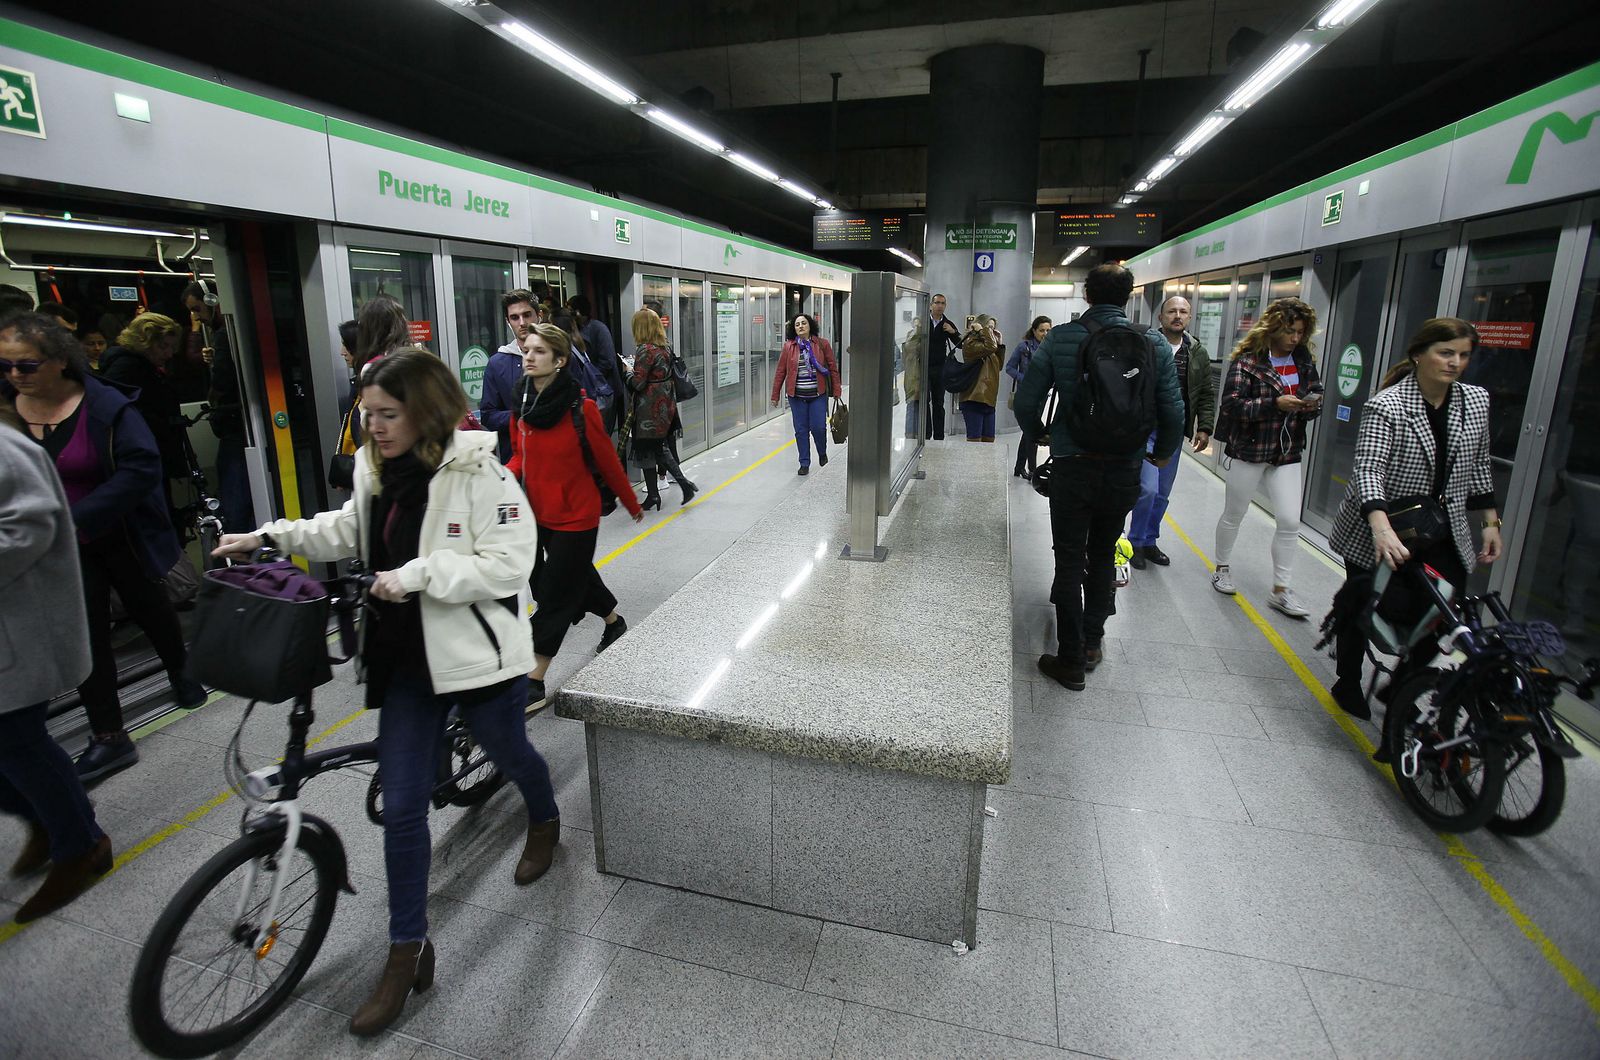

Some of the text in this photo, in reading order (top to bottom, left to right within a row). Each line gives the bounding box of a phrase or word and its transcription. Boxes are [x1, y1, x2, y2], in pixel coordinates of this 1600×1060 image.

[378, 169, 509, 218] Puerta Jerez
[465, 369, 484, 380] Metr
[1341, 366, 1358, 377] Metro
